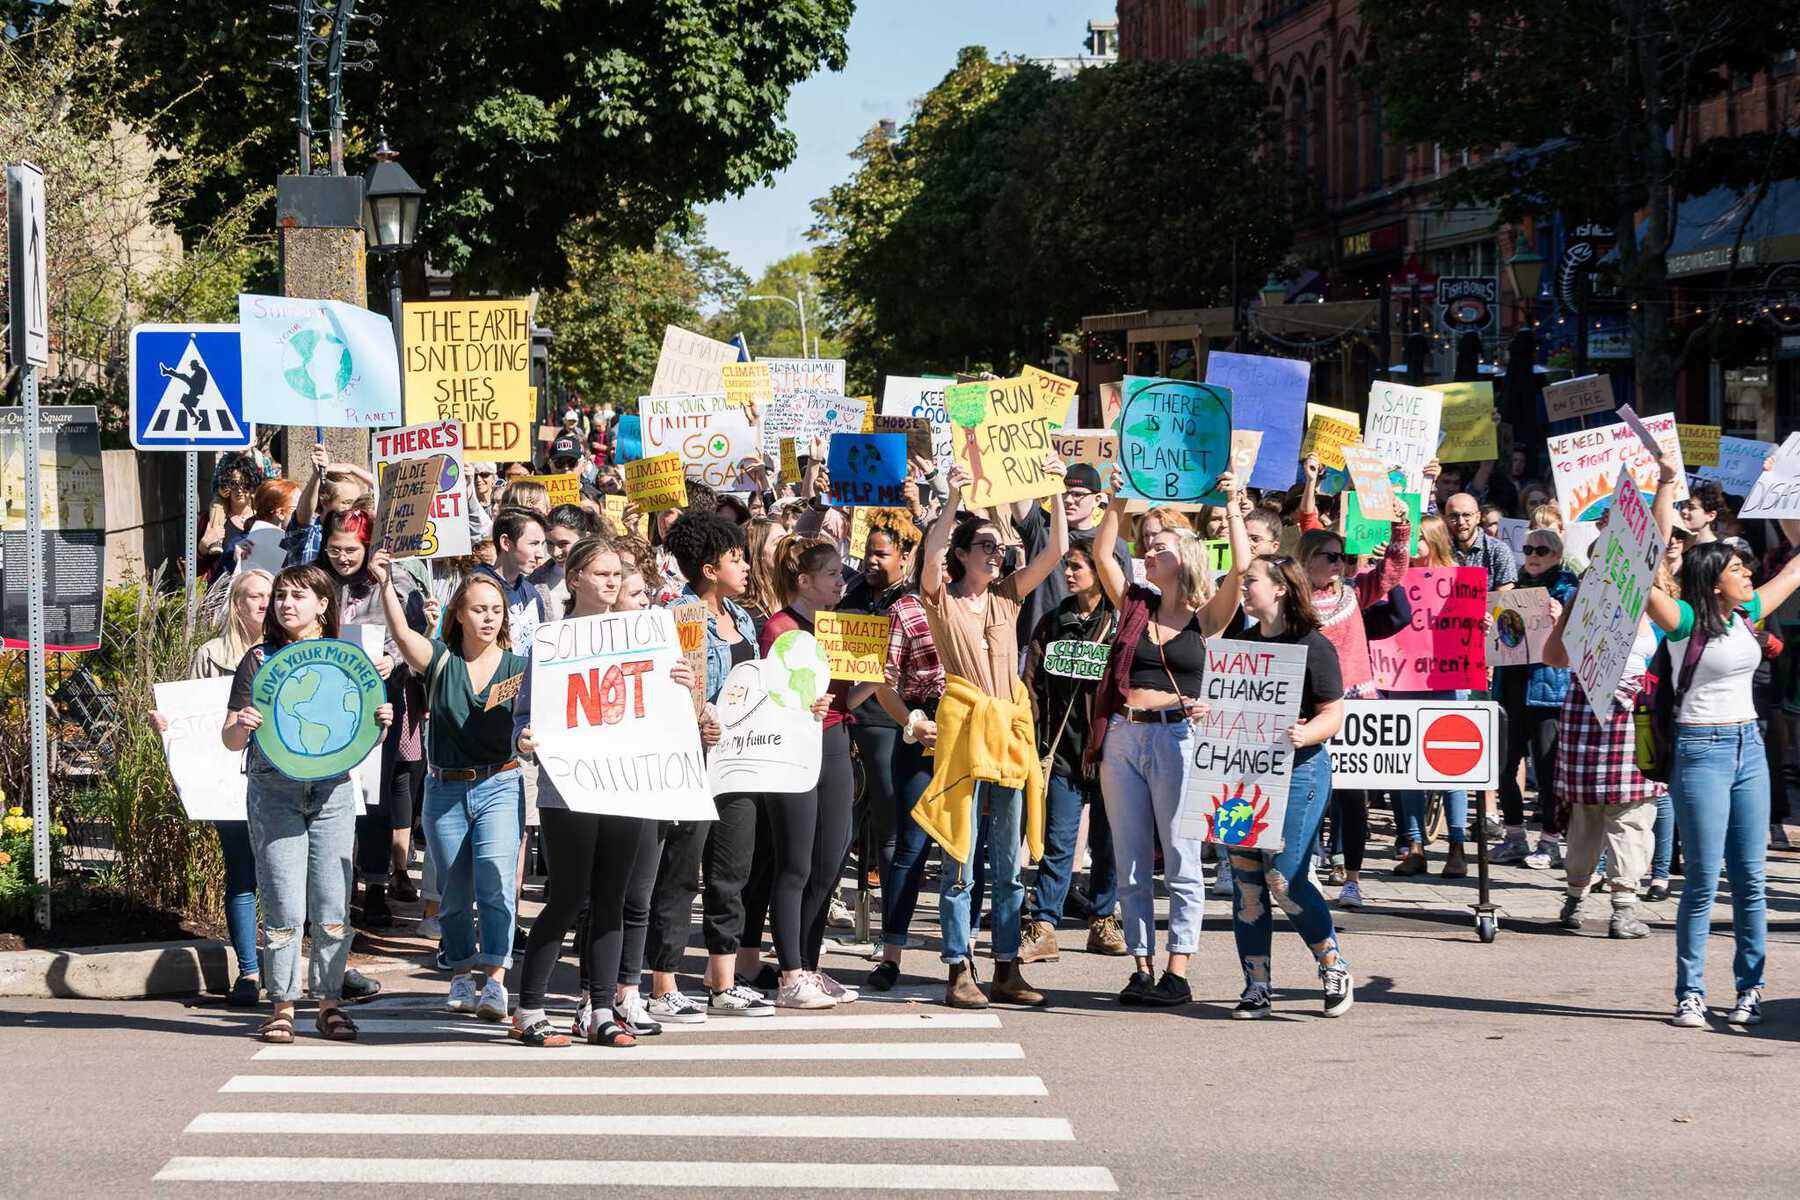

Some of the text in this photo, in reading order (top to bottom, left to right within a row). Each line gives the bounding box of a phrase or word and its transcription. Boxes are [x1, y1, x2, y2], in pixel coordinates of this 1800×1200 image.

[413, 308, 528, 342] THE EARTH
[466, 343, 527, 372] DYING
[722, 365, 767, 377] CLIMATE
[437, 400, 499, 423] BEING
[679, 398, 706, 414] YOUR
[920, 391, 944, 406] KEE
[990, 384, 1034, 416] RUN
[1149, 392, 1204, 416] THERE
[1382, 390, 1424, 416] SAVE
[41, 412, 73, 424] Square
[346, 408, 397, 422] PLANET
[876, 415, 920, 428] CHOOSE
[1145, 414, 1196, 436] IS NO
[1372, 413, 1428, 439] MOTHER
[56, 423, 88, 434] Square
[377, 421, 459, 457] THERE'S
[462, 422, 520, 451] LLED
[988, 416, 1050, 454] FOREST
[683, 433, 731, 459] GO
[1131, 442, 1213, 472] PLANET
[1550, 439, 1569, 456] WE
[1572, 432, 1605, 449] NEED
[409, 462, 430, 481] DIE
[1556, 448, 1613, 473] TO FIGHT
[830, 480, 873, 503] HELP
[1165, 473, 1180, 497] B
[681, 605, 706, 623] WANT
[536, 613, 668, 663] SOLUTION
[816, 617, 889, 640] CLIMATE
[256, 645, 378, 706] LOVE YOUR MOTHER
[846, 660, 885, 675] NOW!
[1208, 650, 1275, 677] WANT
[567, 660, 655, 729] NOT
[1208, 677, 1289, 705] CHANGE
[1205, 710, 1287, 745] MAKE
[1330, 713, 1412, 747] LOSED
[732, 734, 744, 755] my
[746, 729, 783, 747] future
[548, 751, 704, 793] POLLUTION
[1194, 742, 1286, 776] CHANGE
[1373, 752, 1412, 774] ONLY
